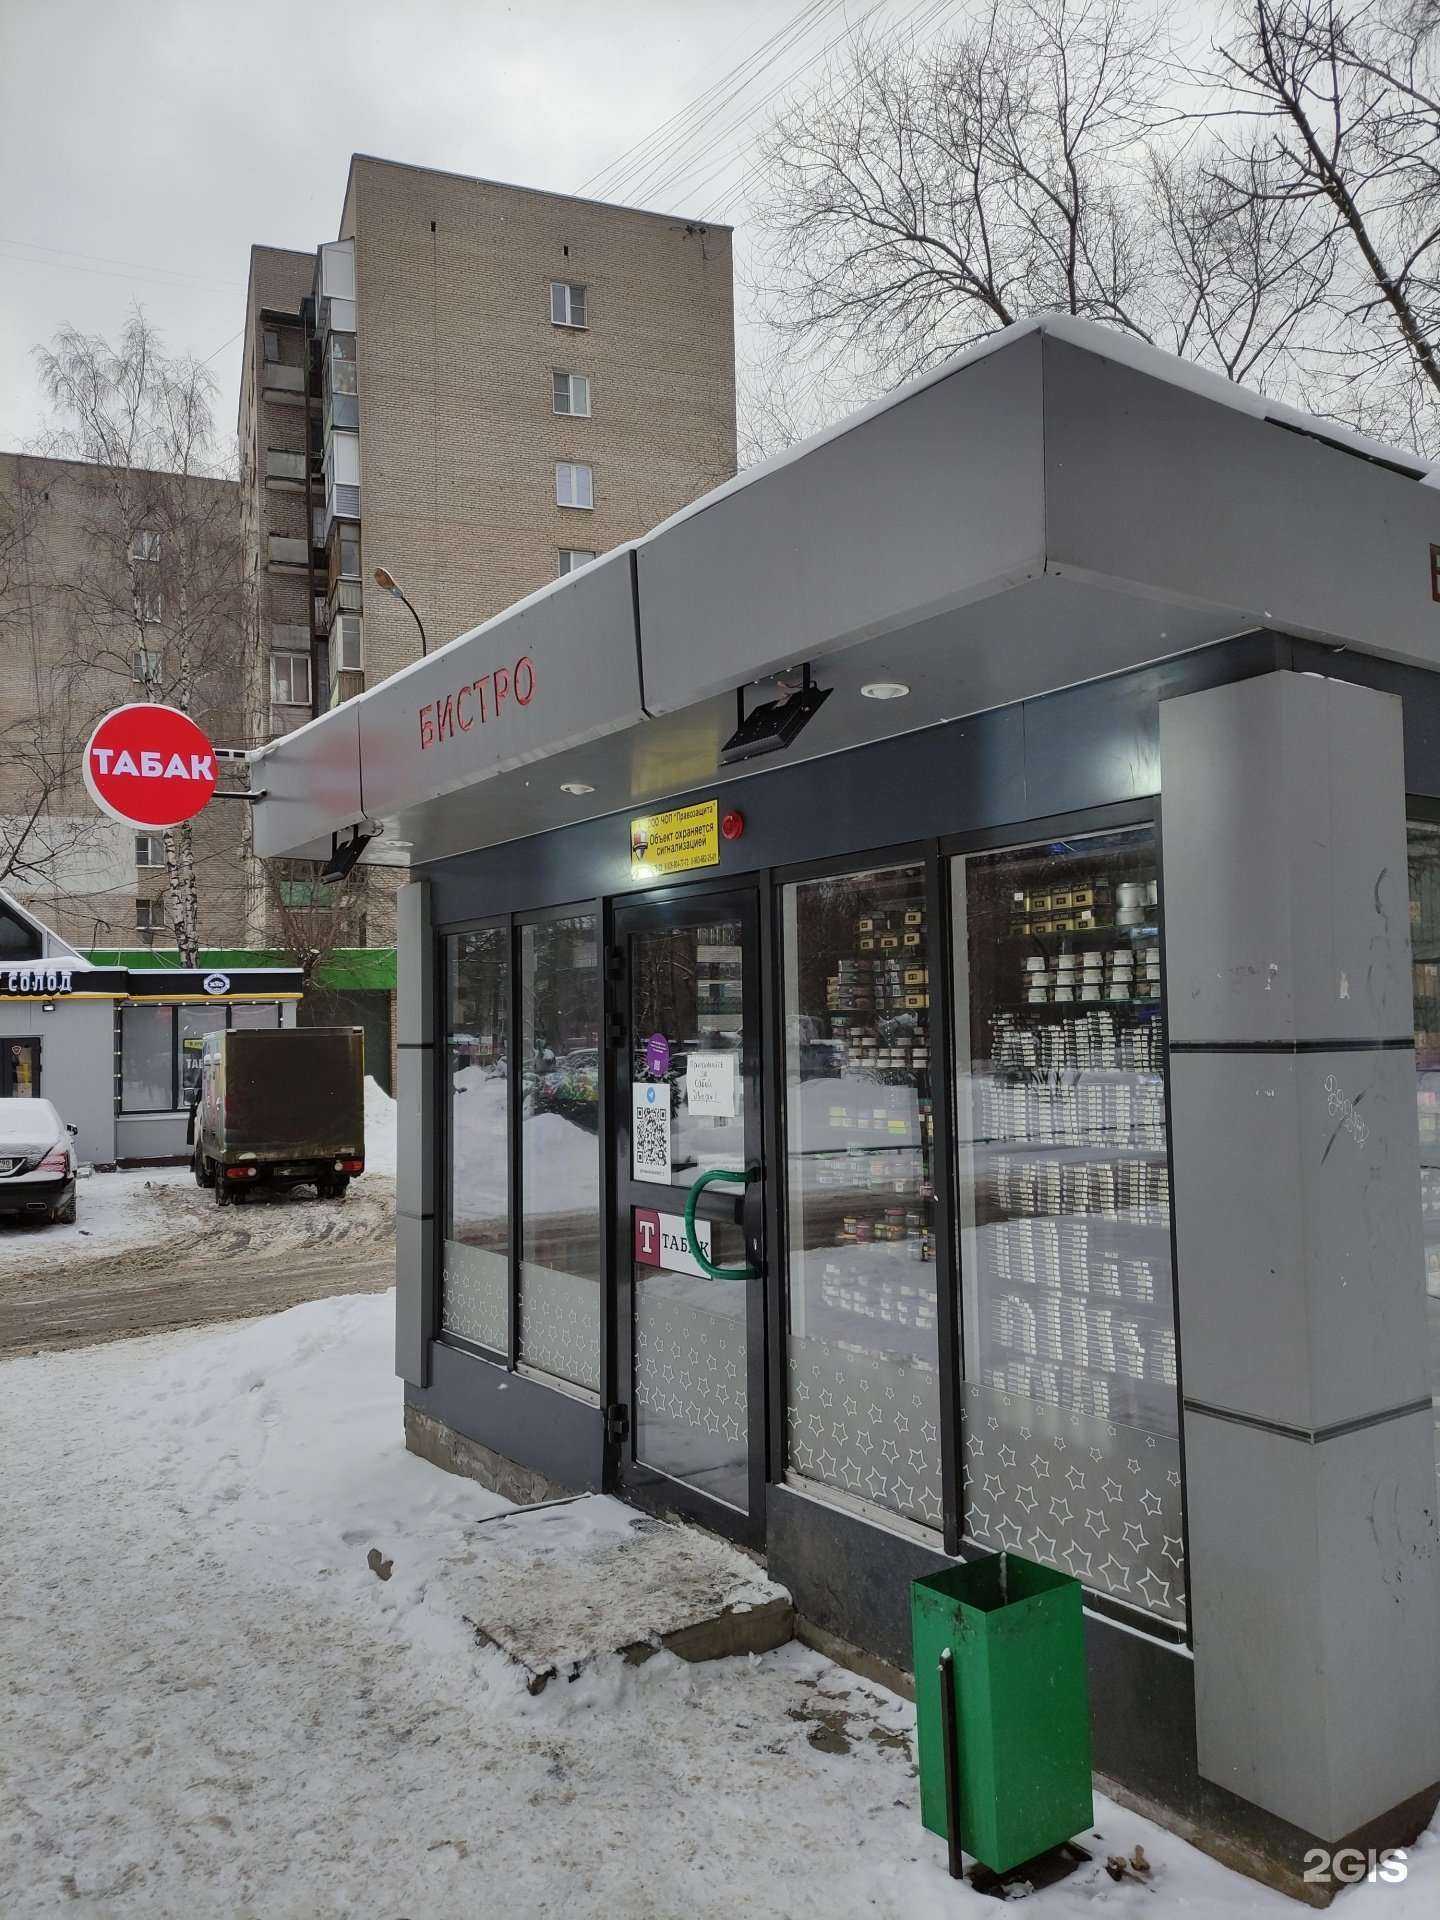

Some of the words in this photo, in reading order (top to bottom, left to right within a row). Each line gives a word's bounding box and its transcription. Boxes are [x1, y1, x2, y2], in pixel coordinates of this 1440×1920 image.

[419, 656, 535, 750] БИСТРО
[92, 748, 214, 780] ТАБАК
[661, 813, 673, 825] ЧОП
[649, 832, 674, 846] Объект
[674, 823, 714, 841] охраняется
[656, 836, 707, 856] сигнализацией
[8, 972, 72, 992] СОЛОД
[639, 1220, 655, 1254] Т
[662, 1232, 710, 1258] ТАБК
